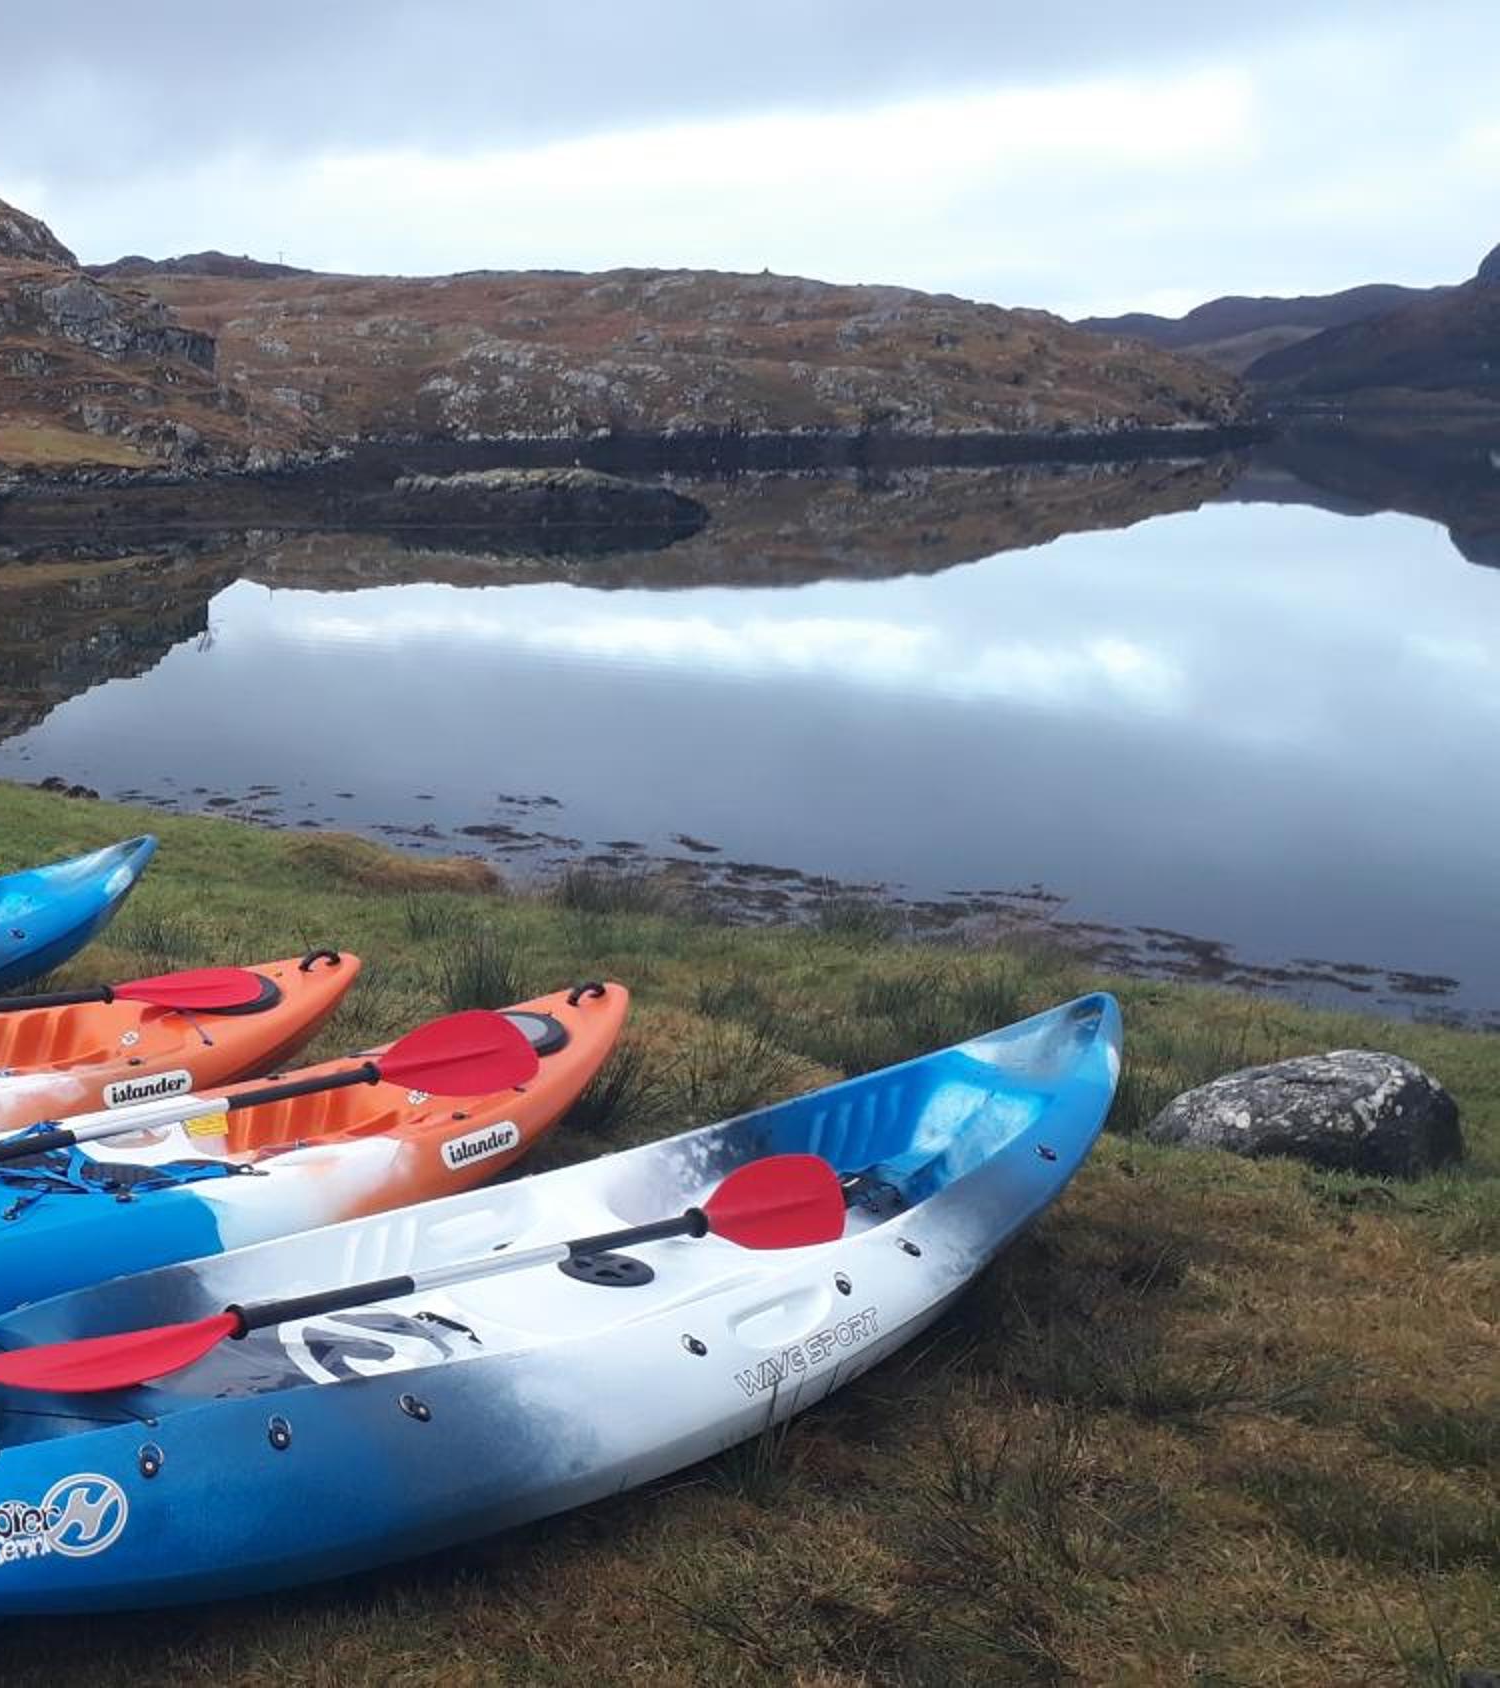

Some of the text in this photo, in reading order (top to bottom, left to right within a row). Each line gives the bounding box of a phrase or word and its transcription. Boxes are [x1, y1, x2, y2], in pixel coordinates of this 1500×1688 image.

[112, 1077, 187, 1104] islander
[448, 1130, 513, 1164] islander
[734, 1306, 879, 1397] WAVE SPORT
